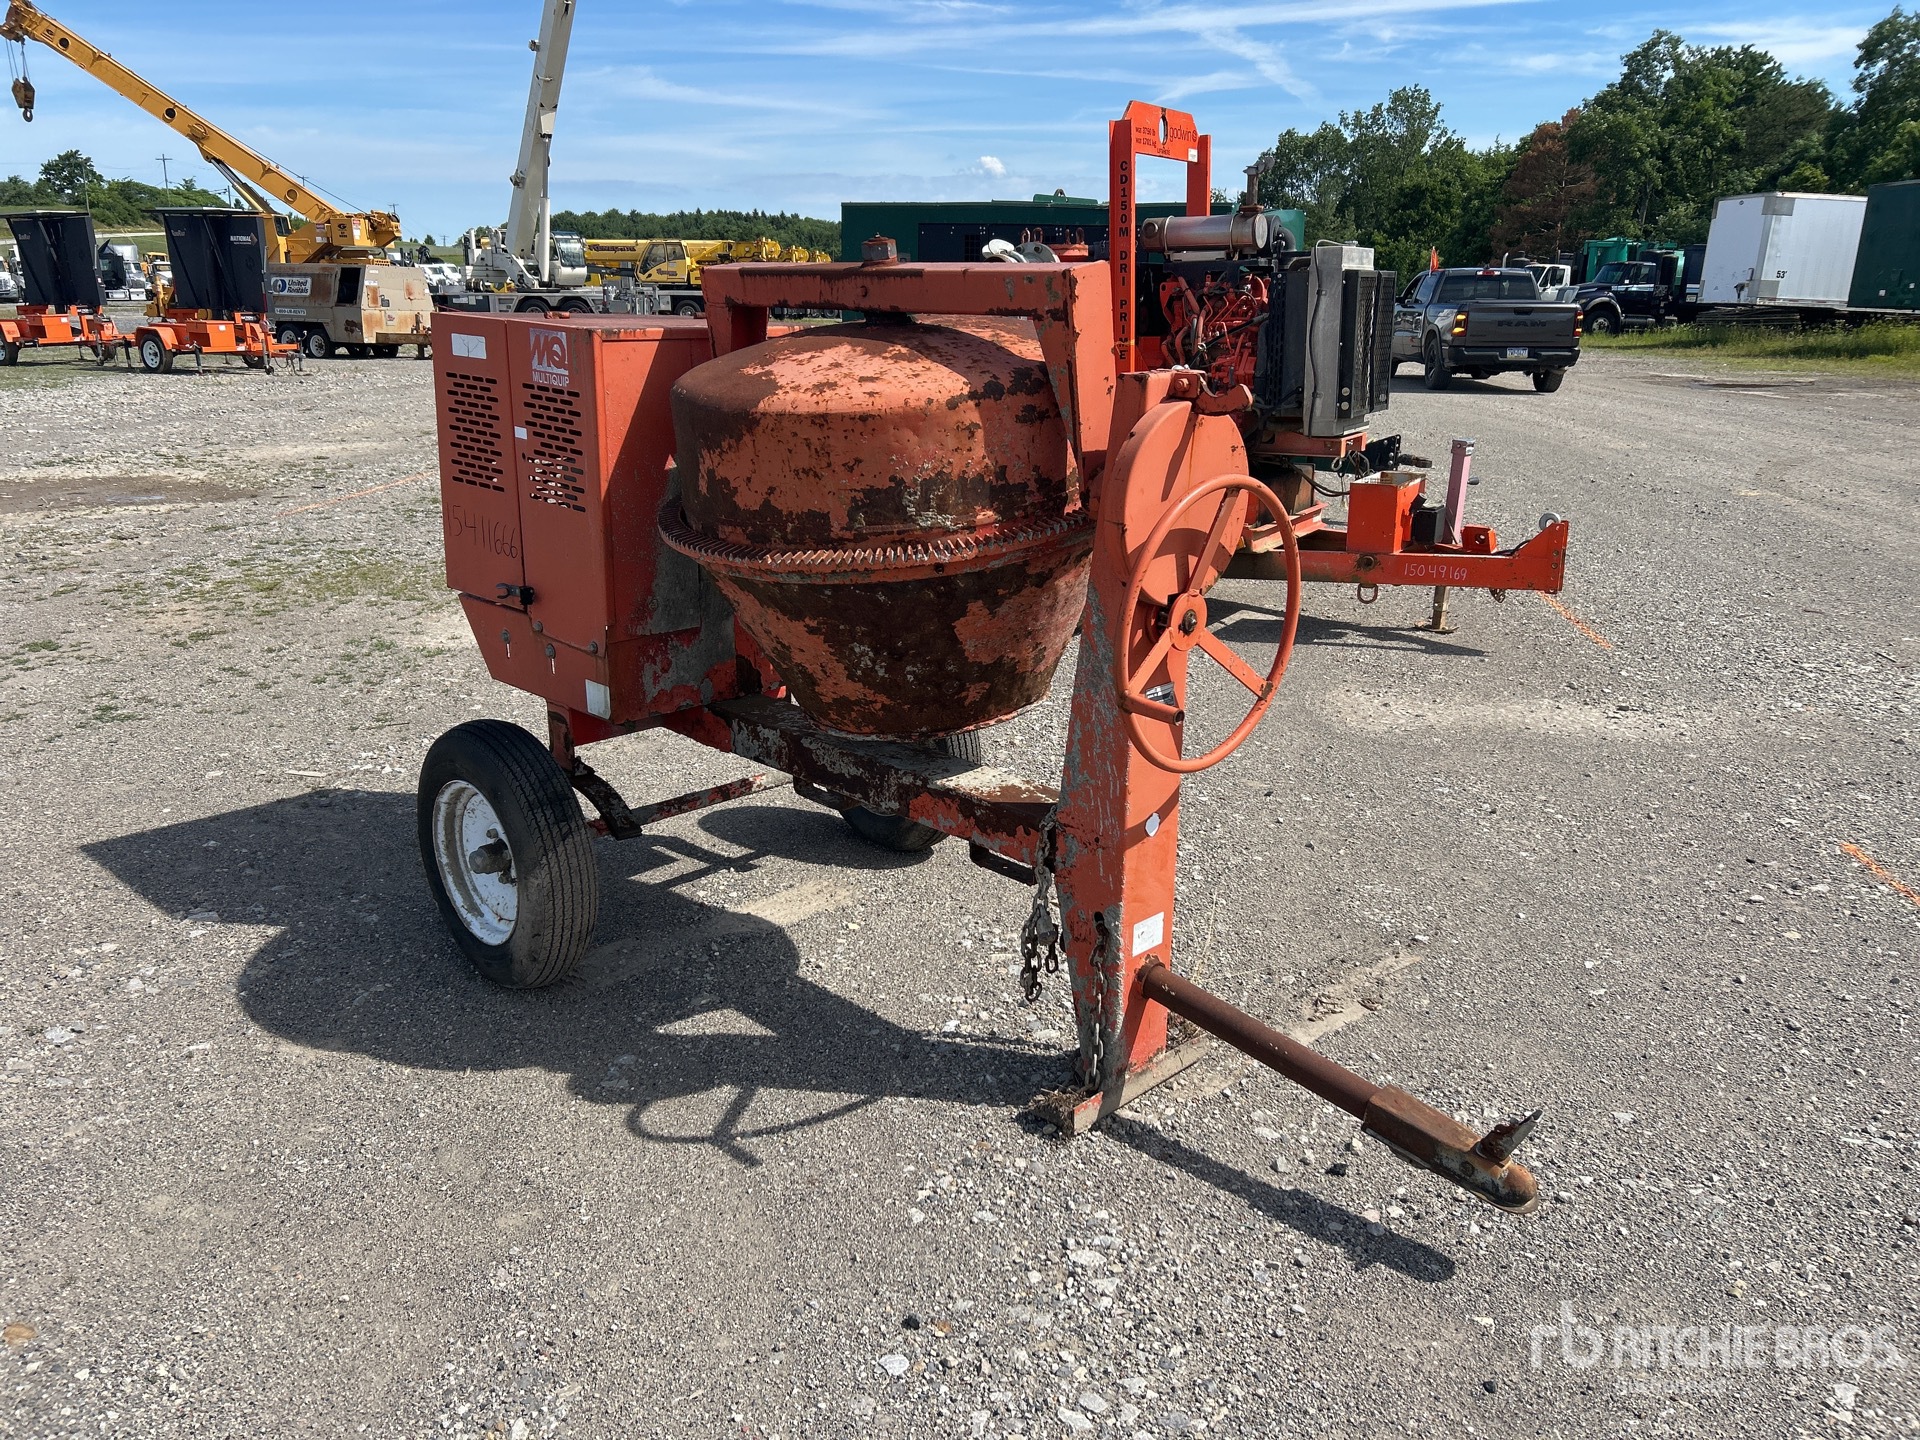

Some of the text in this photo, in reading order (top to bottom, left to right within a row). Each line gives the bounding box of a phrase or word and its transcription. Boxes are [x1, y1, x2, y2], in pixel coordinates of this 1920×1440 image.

[1169, 125, 1192, 142] godwin
[1119, 161, 1129, 360] CD150M DRI PRIME
[1497, 320, 1547, 328] RAM
[530, 333, 567, 370] MQ
[532, 371, 569, 387] MULTIQUIP
[446, 502, 519, 559] 15411666
